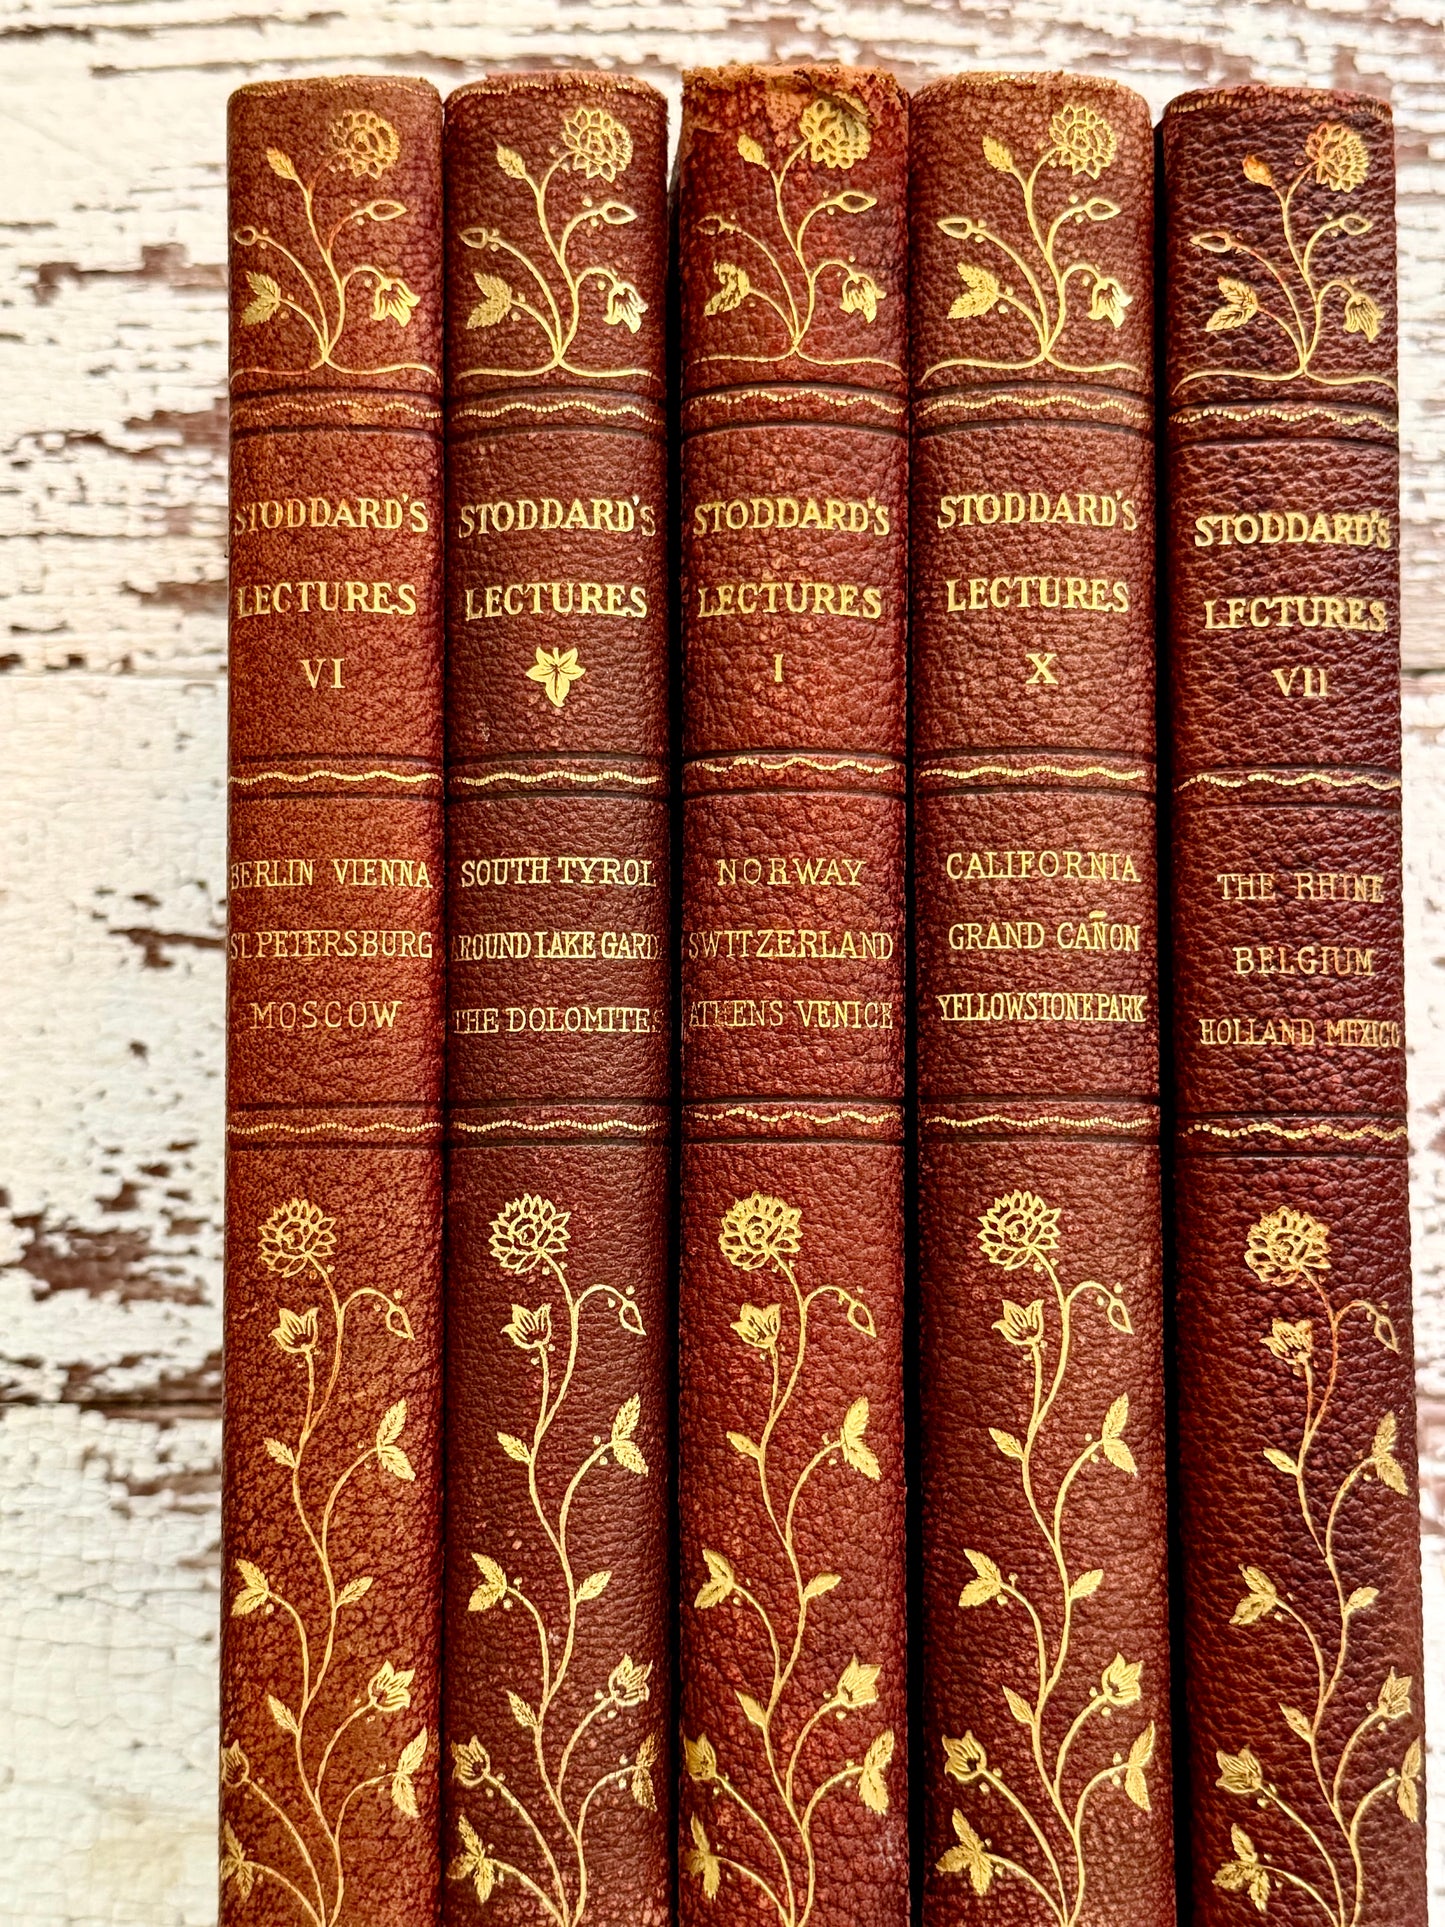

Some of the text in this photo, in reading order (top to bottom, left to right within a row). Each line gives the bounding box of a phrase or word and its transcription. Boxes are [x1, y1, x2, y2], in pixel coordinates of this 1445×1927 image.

[234, 492, 429, 536] STODDARD'S
[458, 494, 656, 539] STODDARD'S
[693, 496, 890, 536] STODDARD'S
[937, 490, 1138, 531] STODDARD'S
[1194, 508, 1391, 549] STODDARD'S
[238, 581, 417, 619] LECTURES
[465, 582, 648, 622] LECTURES
[698, 581, 883, 619] LECTURES
[946, 576, 1130, 613] LECTURES
[1204, 596, 1387, 632] LECTURES
[300, 658, 346, 689] VI
[773, 653, 784, 683] I
[1025, 653, 1059, 685] X
[1271, 666, 1328, 697] VII
[230, 858, 433, 890] BERLIN VIENNA
[461, 857, 657, 888] SOUTH TYROL
[716, 858, 867, 886] NORWAY
[946, 850, 1141, 883] CALIFORNIA
[1217, 873, 1385, 904] THE RHINE
[255, 930, 433, 959] PETERSBURG
[533, 931, 597, 959] LAKE
[688, 929, 894, 961] SWITZERLAND
[948, 910, 1141, 952] GRAND CAÑON
[1232, 946, 1376, 976] BELGIUM
[249, 1000, 403, 1029] MOSCOW
[453, 1006, 665, 1034] THE DOLOMITES
[689, 1000, 893, 1030] ATHENS VENICE
[936, 992, 1148, 1023] YELLOWSTONE PARK
[1199, 1018, 1400, 1049] HOLLAND MEXICO
